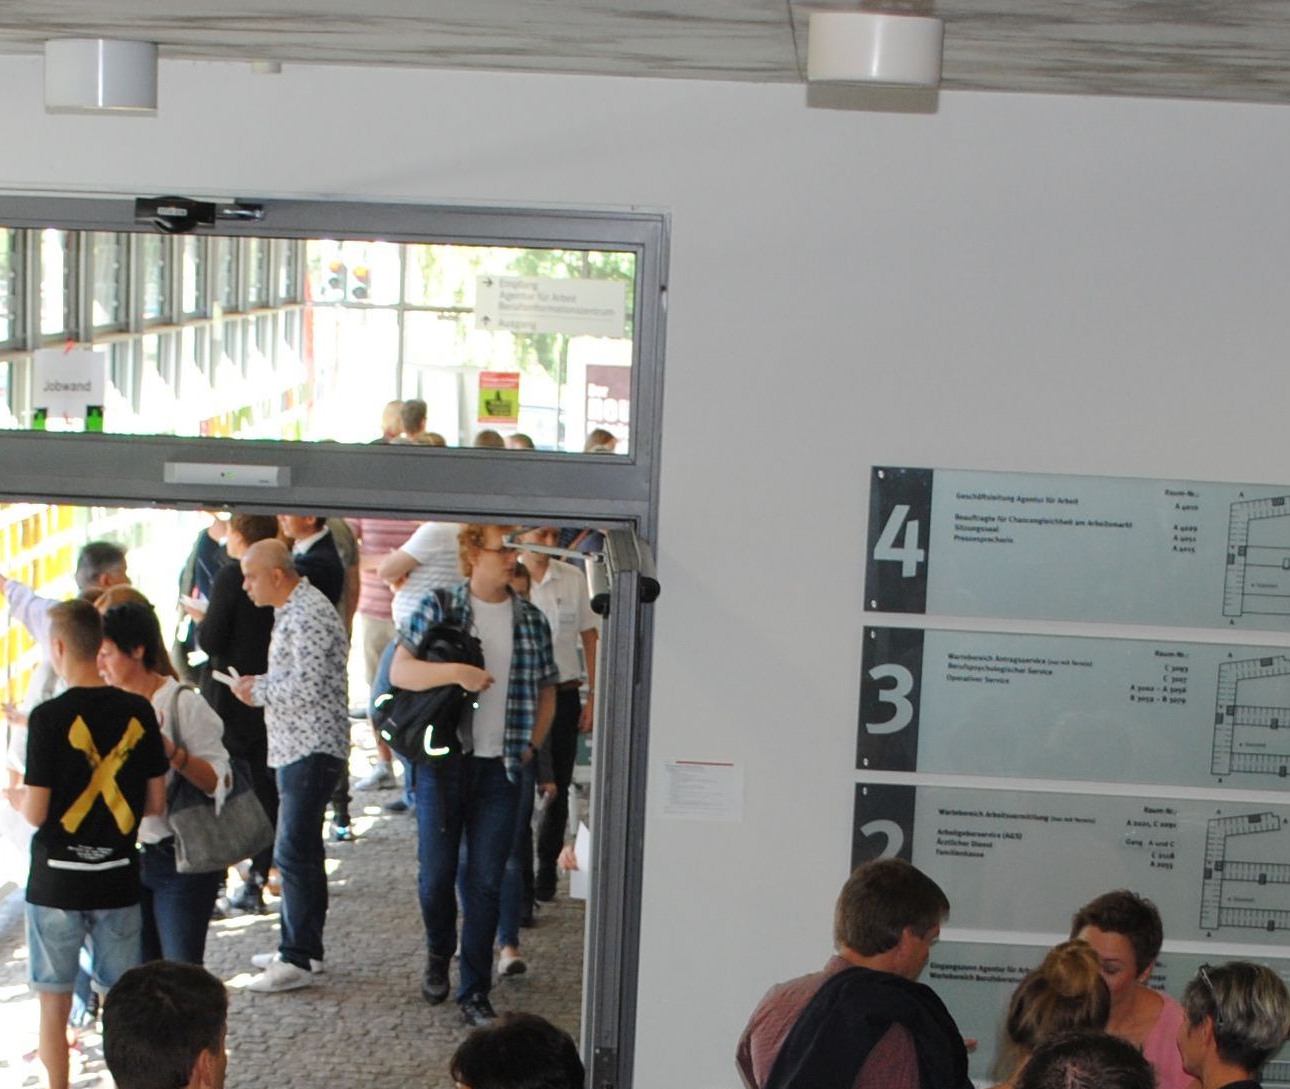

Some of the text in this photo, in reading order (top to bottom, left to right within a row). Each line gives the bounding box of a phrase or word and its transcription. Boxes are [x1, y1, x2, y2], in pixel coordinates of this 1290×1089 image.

[499, 291, 534, 301] Agentur
[552, 292, 577, 302] Arbeit
[43, 380, 92, 392] Jobwand
[873, 504, 924, 578] 4
[1028, 667, 1053, 675] Service
[985, 676, 1010, 684] Service
[866, 664, 913, 735] 3
